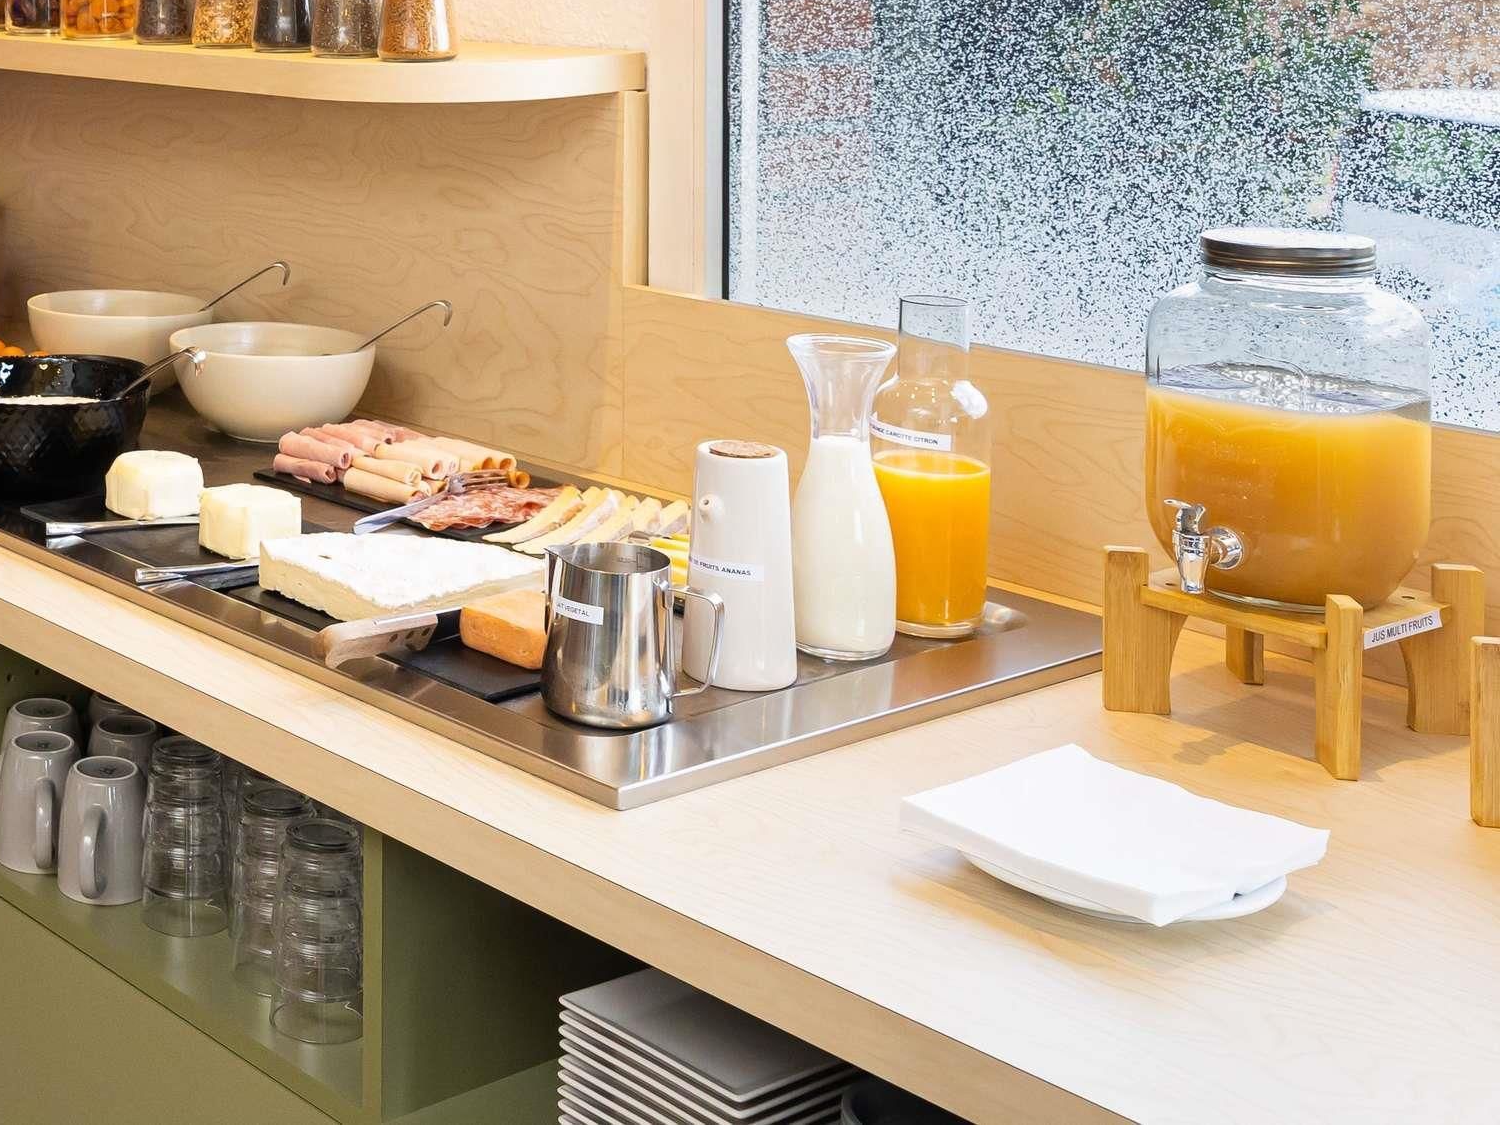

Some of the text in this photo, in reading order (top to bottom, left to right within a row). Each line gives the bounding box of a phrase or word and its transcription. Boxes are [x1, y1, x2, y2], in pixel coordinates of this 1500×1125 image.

[914, 436, 939, 446] CITRON
[721, 566, 752, 576] ANANAS
[1372, 615, 1434, 643] JUS MULTI FRUITS
